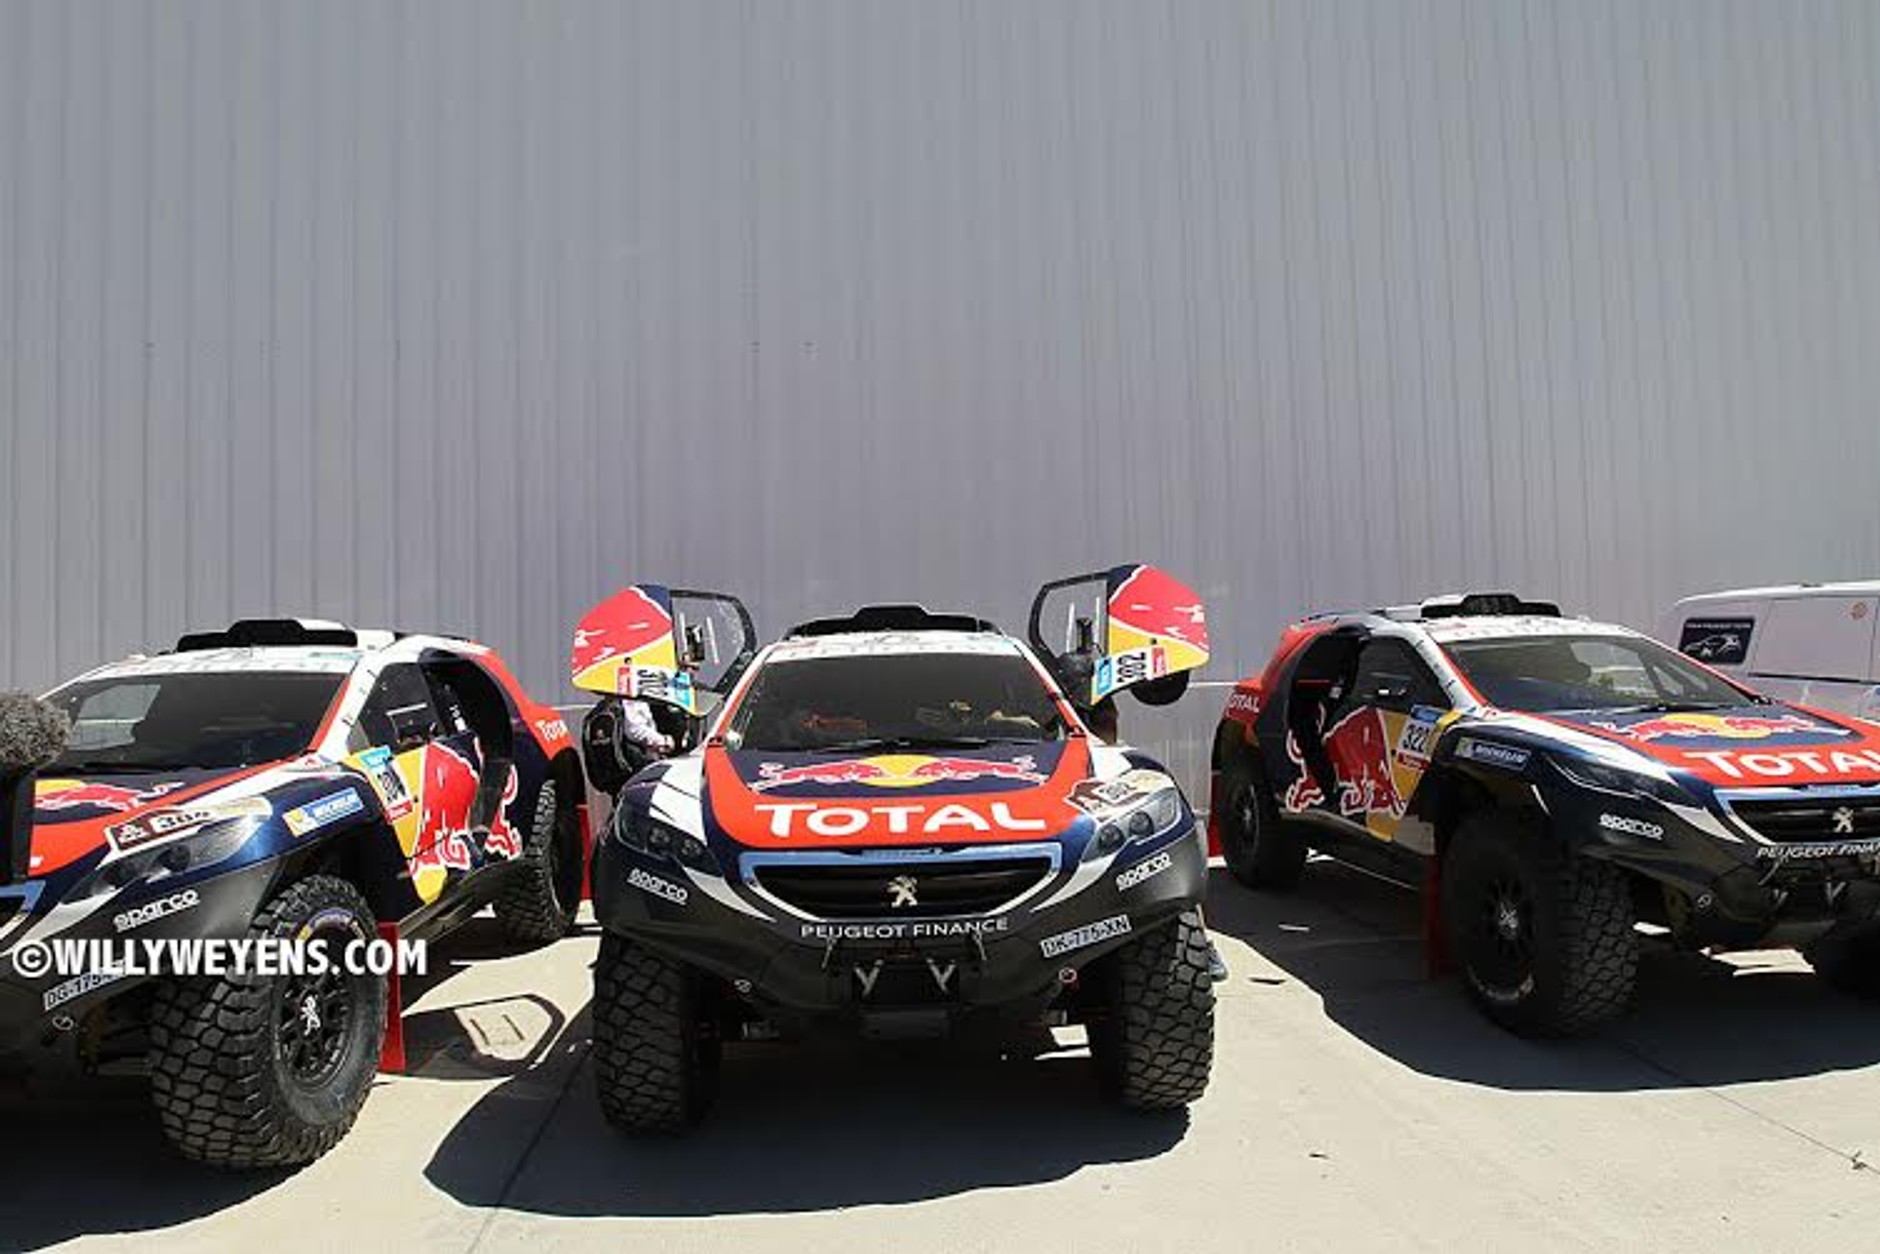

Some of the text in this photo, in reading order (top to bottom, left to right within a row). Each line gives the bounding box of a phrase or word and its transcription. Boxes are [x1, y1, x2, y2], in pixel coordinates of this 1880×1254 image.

[754, 802, 1047, 838] TOTAL
[112, 889, 201, 934] sparco
[801, 917, 1009, 939] PEUGEOT FINANCE
